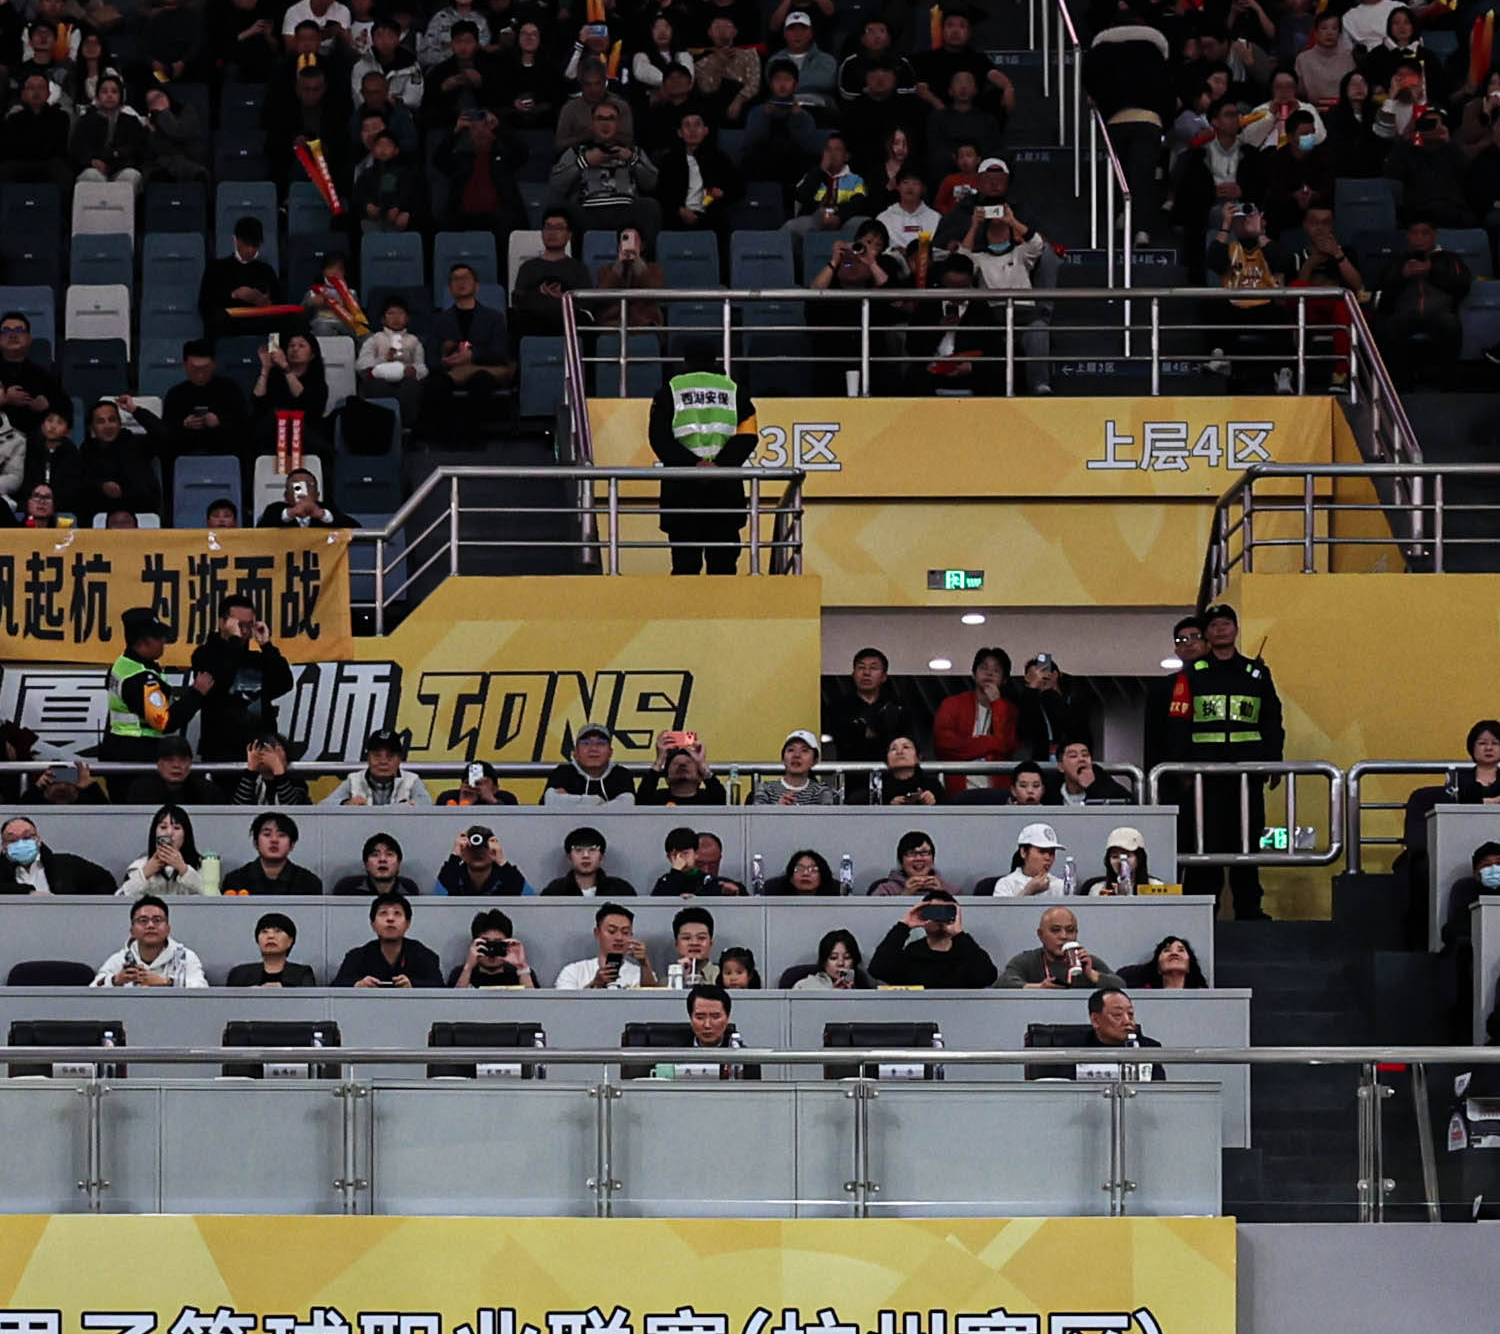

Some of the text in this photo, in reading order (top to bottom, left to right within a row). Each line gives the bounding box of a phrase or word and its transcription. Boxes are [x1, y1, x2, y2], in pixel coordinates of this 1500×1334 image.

[681, 390, 728, 406] 西湖安保
[1087, 420, 1274, 471] 上层4区
